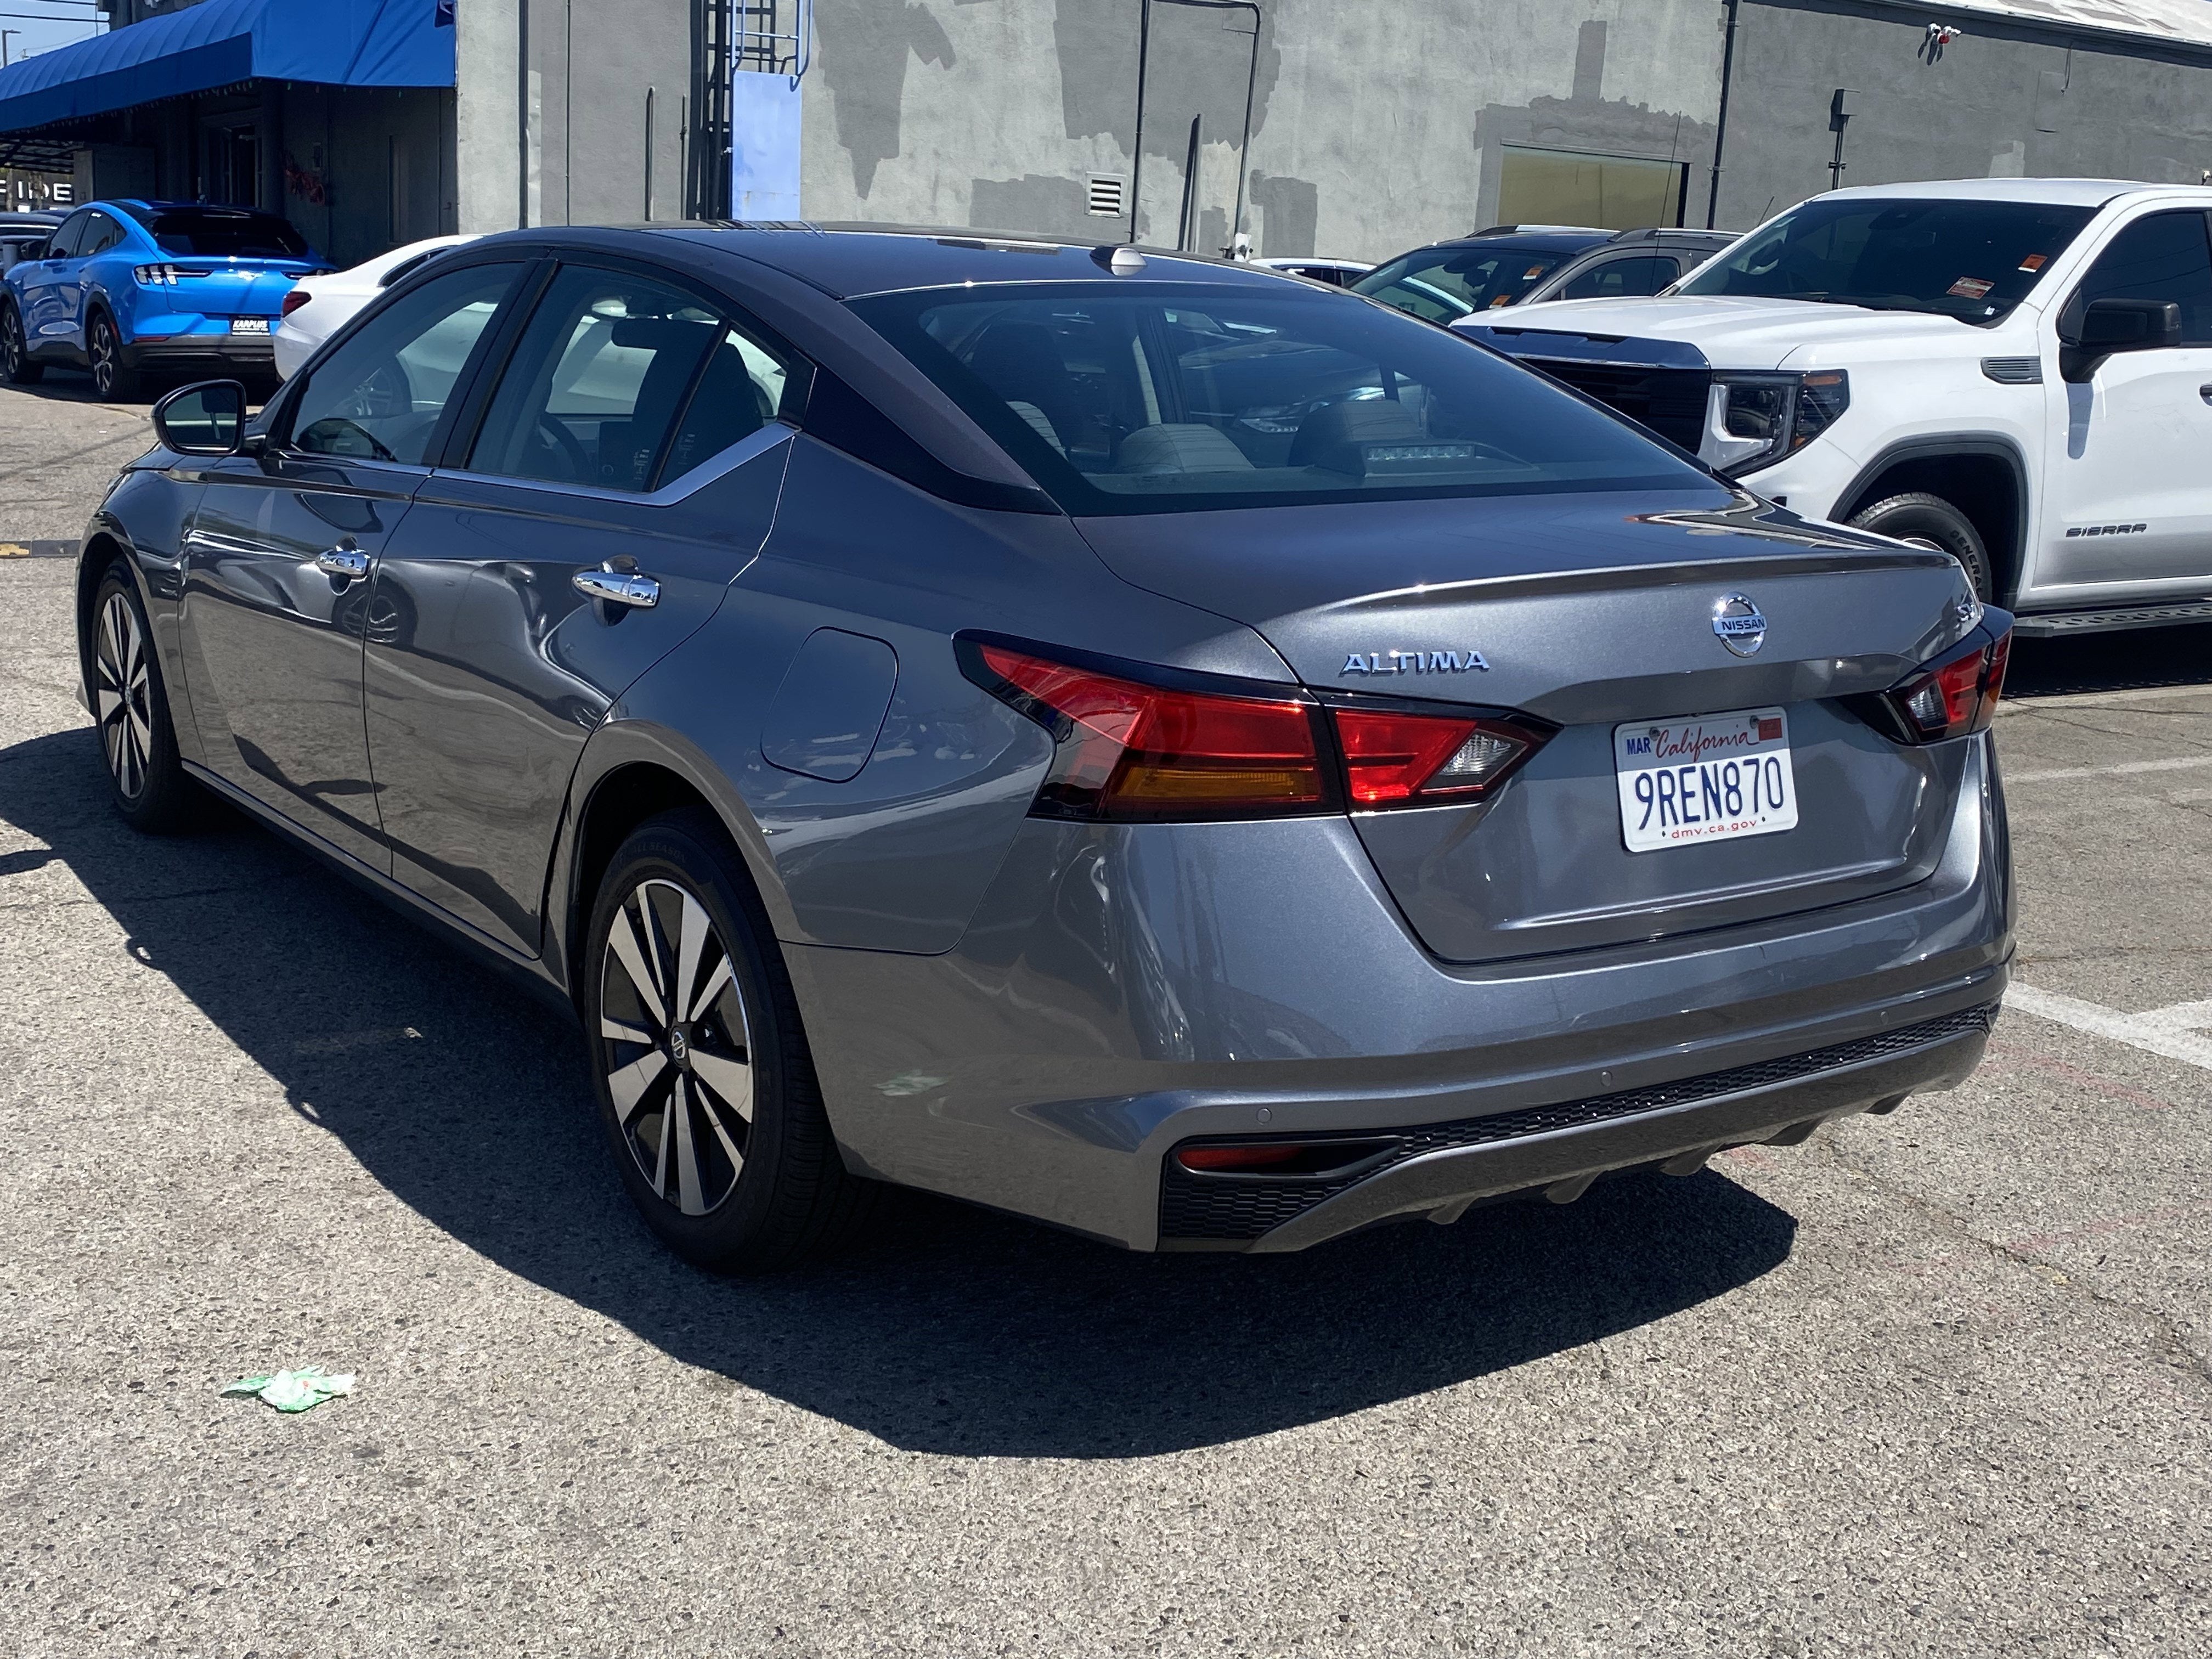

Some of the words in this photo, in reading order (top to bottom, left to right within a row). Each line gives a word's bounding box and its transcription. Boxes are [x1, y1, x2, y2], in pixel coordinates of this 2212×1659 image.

[2066, 523, 2147, 538] SIERRA
[1722, 618, 1765, 630] NISSAN
[1340, 650, 1490, 676] ALTIMA
[1627, 737, 1651, 755] MAR
[1655, 725, 1759, 762] California
[1635, 757, 1784, 831] 9REN870
[1671, 820, 1757, 839] dmv.ca.gov
